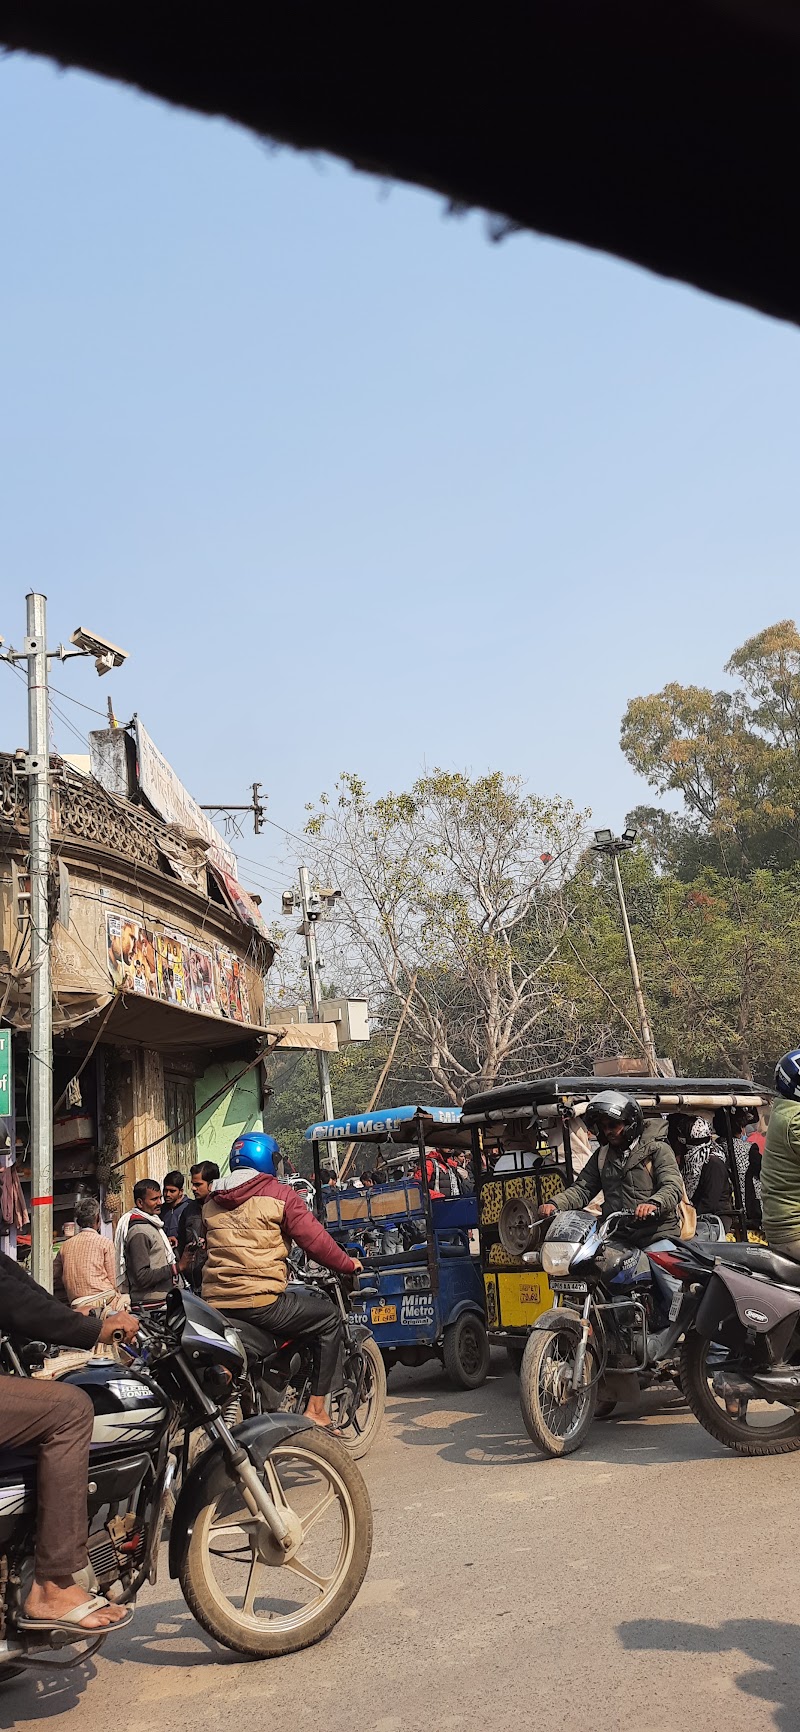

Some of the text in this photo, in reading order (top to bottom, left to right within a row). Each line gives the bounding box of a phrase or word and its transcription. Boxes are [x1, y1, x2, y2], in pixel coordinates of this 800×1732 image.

[402, 1294, 433, 1306] Mini
[406, 1306, 434, 1317] Metro
[348, 1313, 368, 1324] etro
